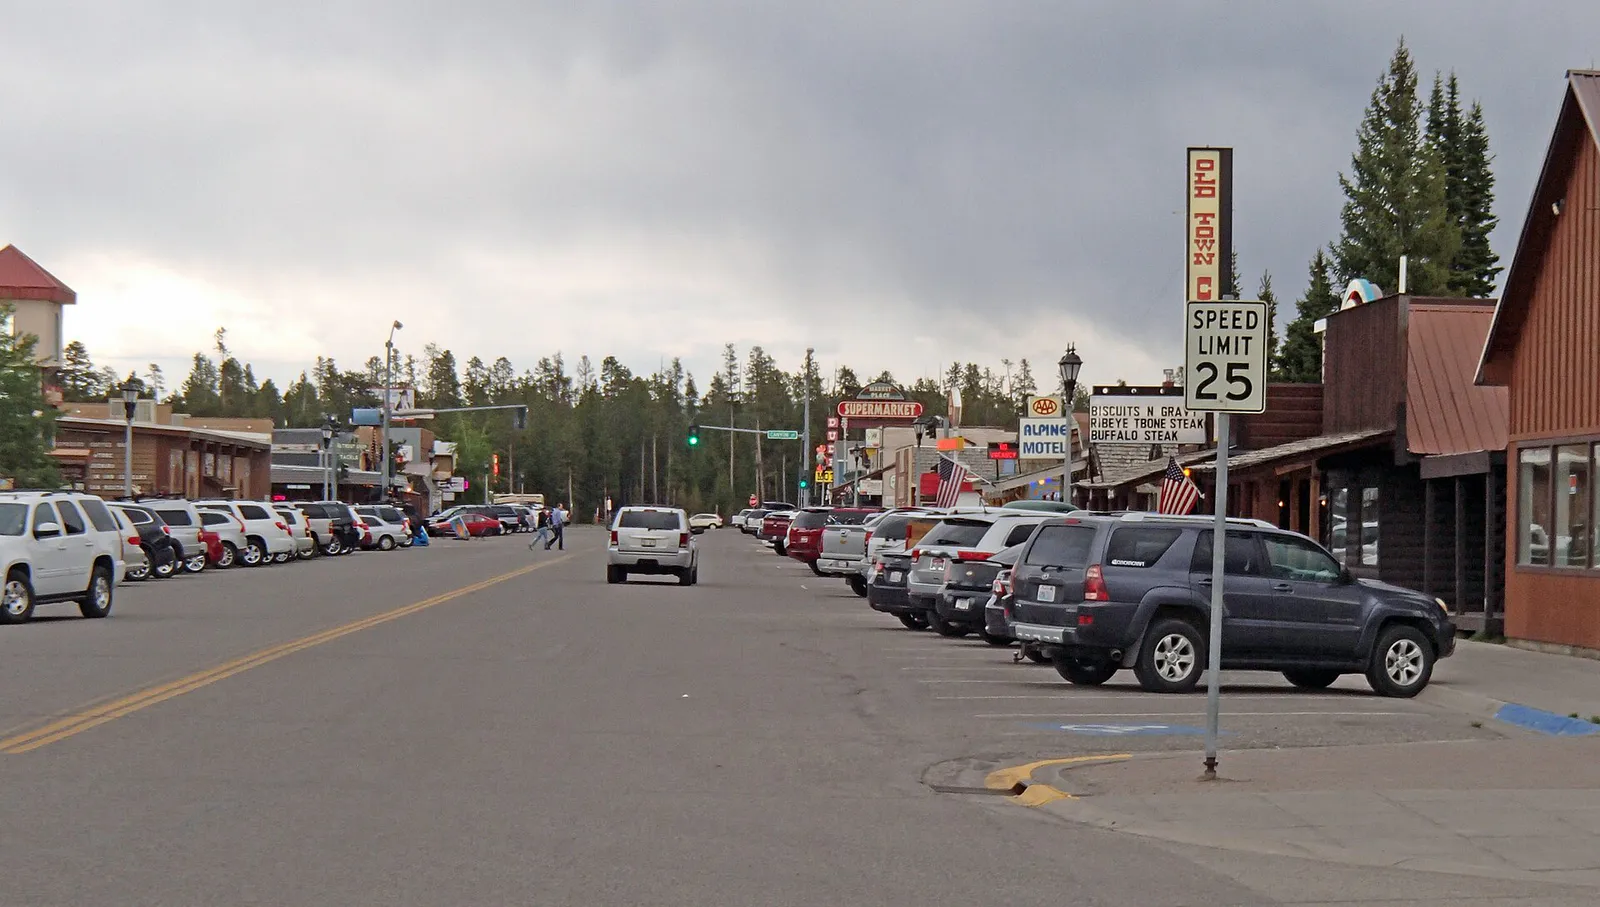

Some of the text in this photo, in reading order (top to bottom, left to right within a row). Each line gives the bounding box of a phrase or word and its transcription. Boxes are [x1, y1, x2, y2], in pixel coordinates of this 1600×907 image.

[1194, 159, 1216, 198] OLD
[1194, 213, 1216, 265] TOWN
[1193, 309, 1258, 330] SPEED
[1198, 336, 1253, 356] LIMIT
[1195, 361, 1253, 401] 25
[844, 403, 916, 416] SUPERMARKET
[1091, 406, 1140, 417] BISCUITS
[1147, 406, 1154, 417] N
[1023, 424, 1067, 436] ALPINE
[1090, 418, 1204, 429] RIBEYE TBONE STEAK
[1091, 430, 1178, 441] BUFFALO STEAK
[1023, 442, 1066, 454] MOTEL
